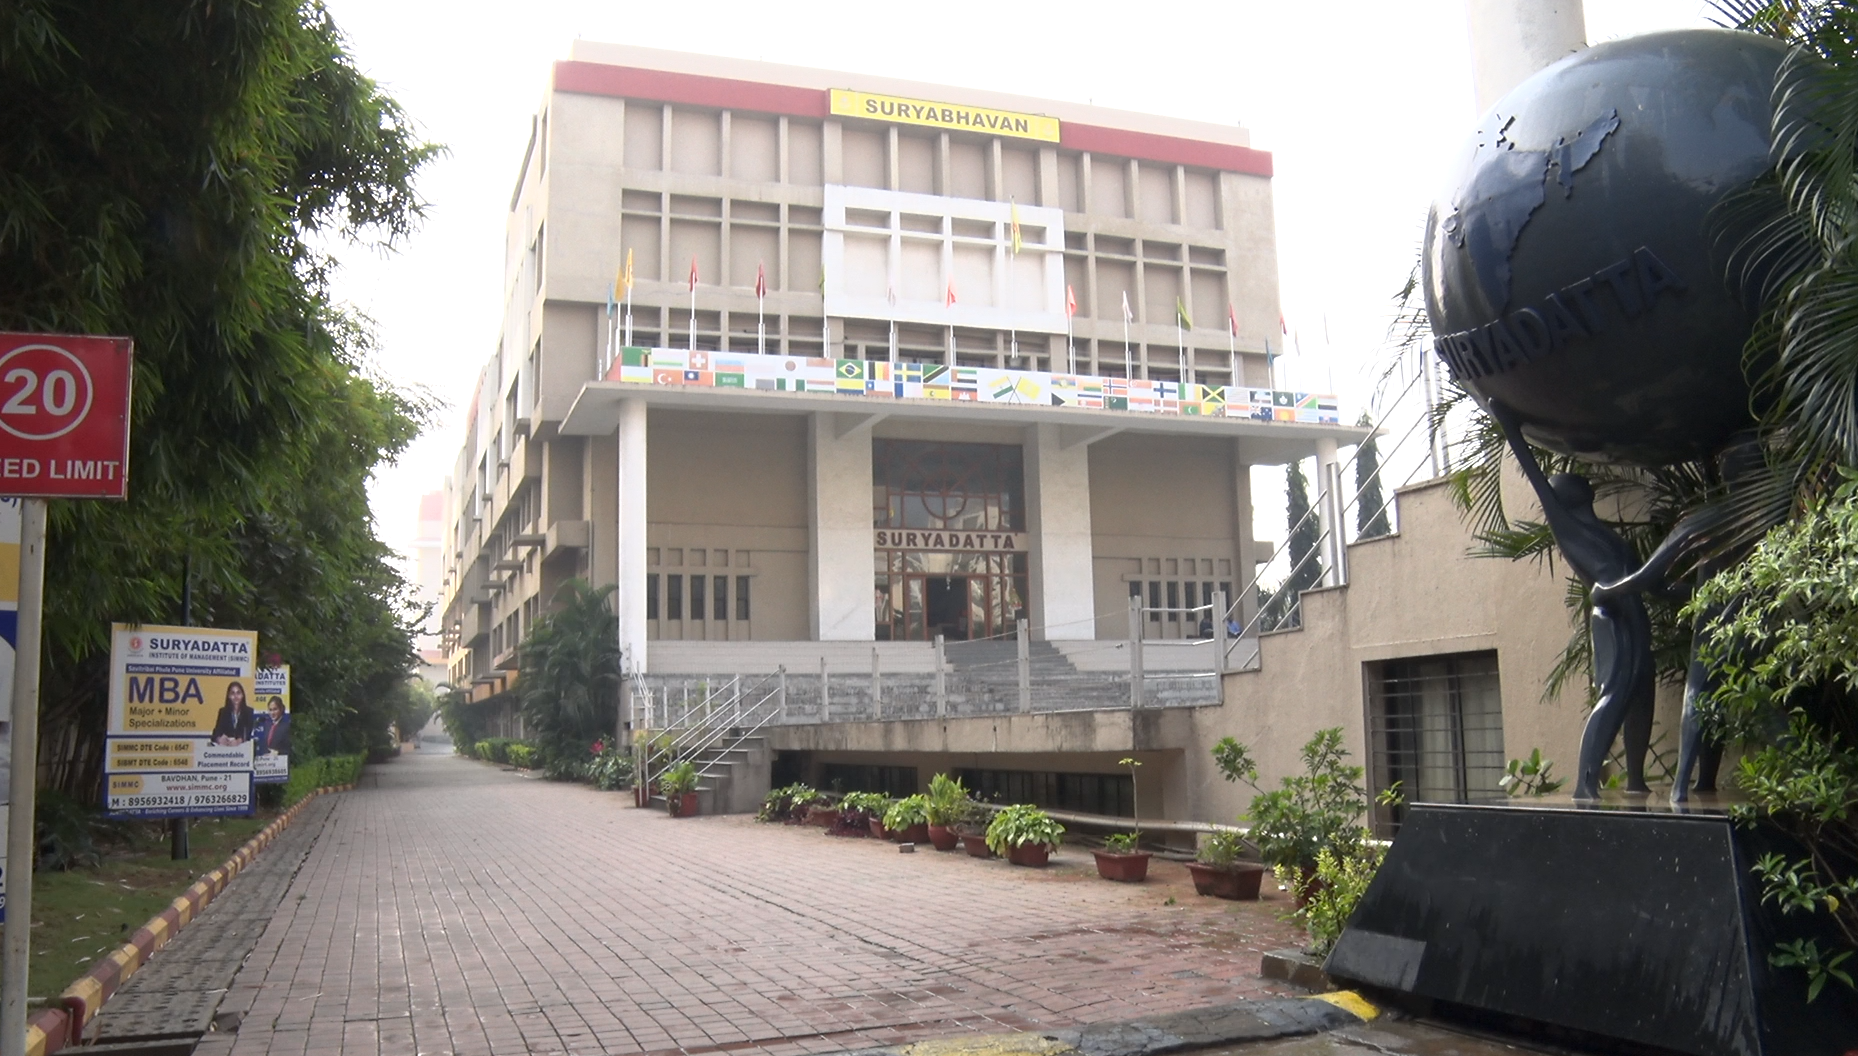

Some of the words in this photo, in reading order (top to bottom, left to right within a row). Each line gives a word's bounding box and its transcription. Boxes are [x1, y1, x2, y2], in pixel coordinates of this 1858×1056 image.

[865, 98, 1029, 133] SURYABHAVAN
[1, 368, 77, 416] 20
[0, 458, 41, 478] ED
[50, 459, 119, 480] LIMIT
[876, 531, 1015, 549] SURYADATTA
[149, 638, 248, 654] SURYADATTA
[149, 652, 180, 660] INSTITUTE
[186, 667, 212, 675] University
[255, 672, 286, 680] DATTA
[128, 676, 204, 705] MBA
[129, 706, 155, 718] Major
[165, 707, 190, 716] Minor
[129, 718, 196, 729] Specializations
[166, 783, 228, 791] www.simmc.org
[111, 798, 120, 807] M
[128, 795, 185, 807] 8956932418
[194, 794, 247, 804] 9763266829
